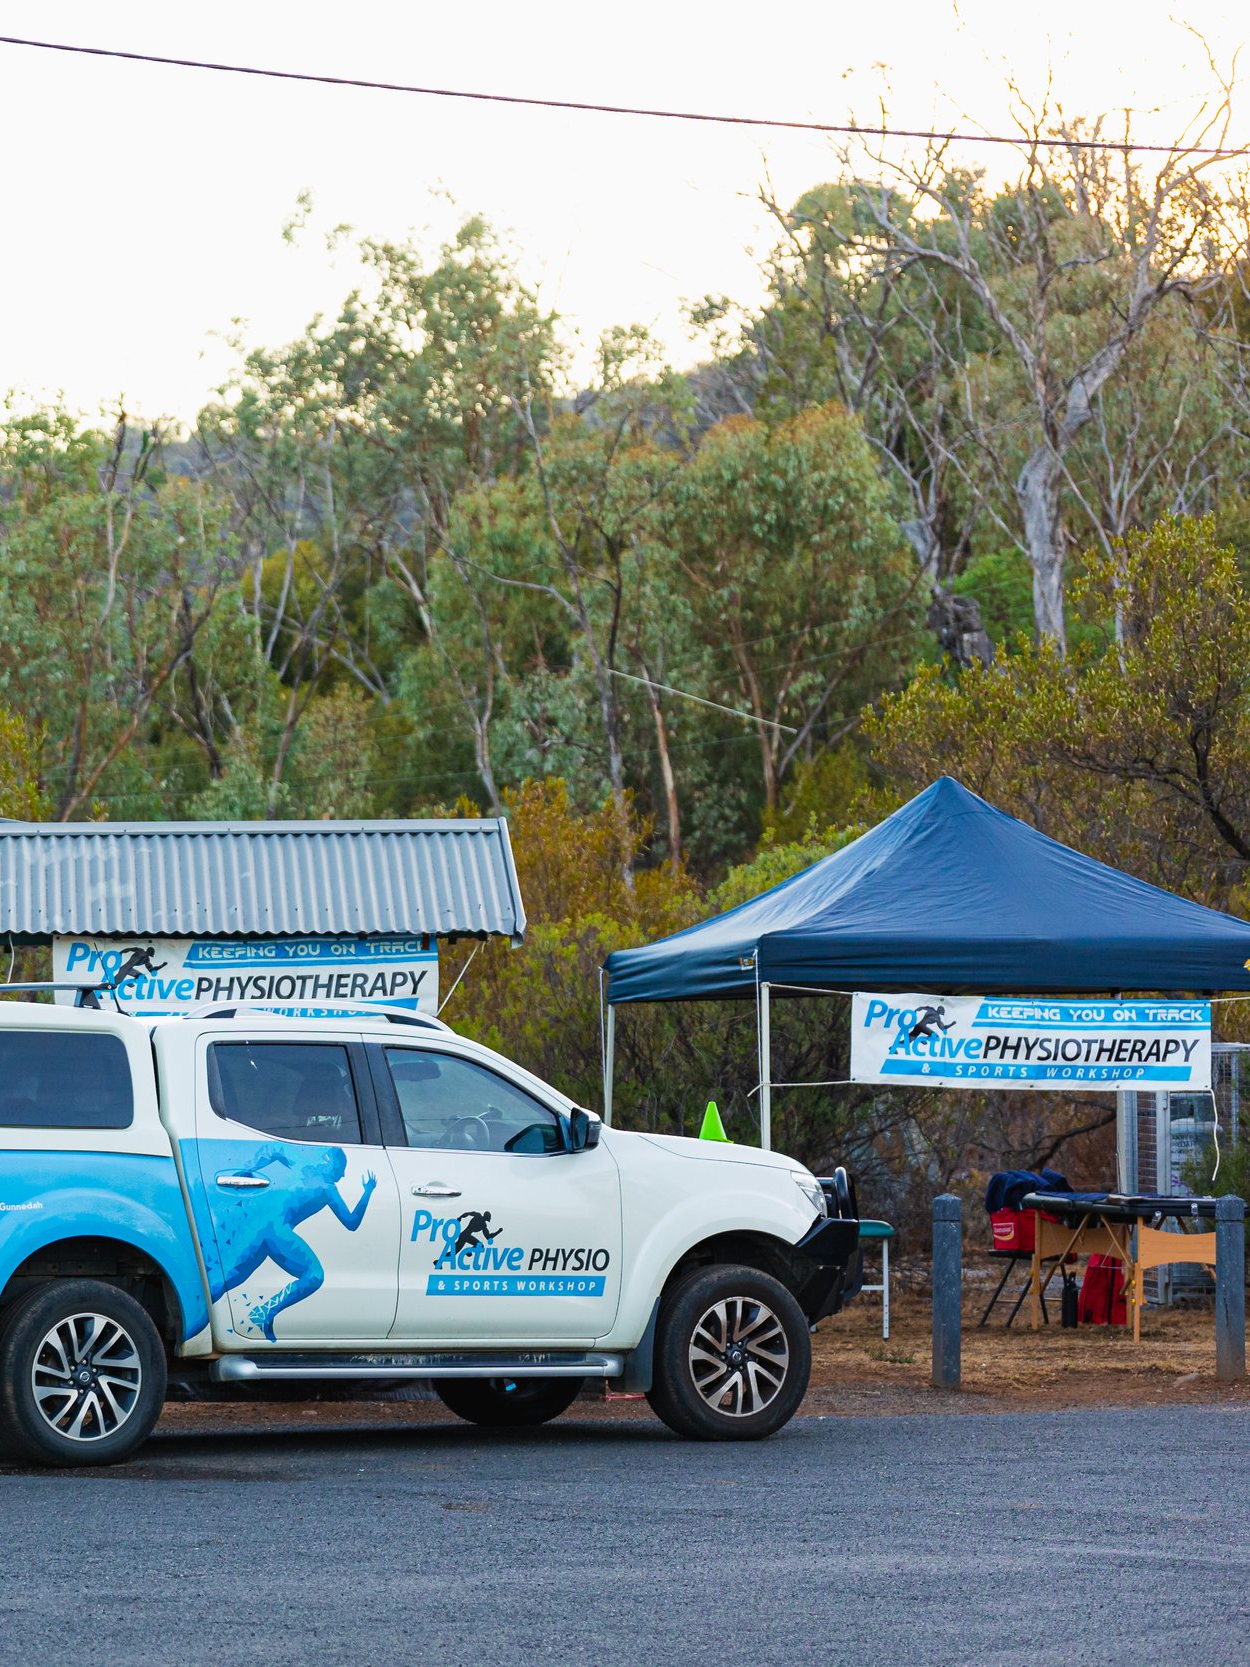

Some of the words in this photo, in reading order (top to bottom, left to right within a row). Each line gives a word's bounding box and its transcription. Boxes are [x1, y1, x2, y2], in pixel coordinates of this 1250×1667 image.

[66, 943, 123, 973] Pro
[285, 943, 321, 957] YOU
[331, 943, 356, 955] ON
[94, 970, 195, 1001] Active
[195, 970, 428, 1001] PHYSIOTHERAPY
[864, 1000, 917, 1029] Pro
[988, 1006, 1061, 1021] KEEPING
[1070, 1009, 1105, 1021] YOU
[1113, 1009, 1137, 1021] ON
[1145, 1009, 1203, 1021] TRACK
[889, 1026, 983, 1060] Active
[982, 1035, 1200, 1063] PHYSIOTHERAPY
[921, 1063, 932, 1074] &
[955, 1065, 1028, 1078] SPORTS
[1046, 1067, 1145, 1079] WORKSHOP
[0, 1201, 44, 1212] Gunnedah
[410, 1209, 462, 1242] Pro
[434, 1237, 525, 1272] Active
[528, 1248, 611, 1272] PHYSIO
[437, 1280, 446, 1291] &
[454, 1280, 508, 1291] SPORTS
[516, 1280, 597, 1292] WORKSHOP
